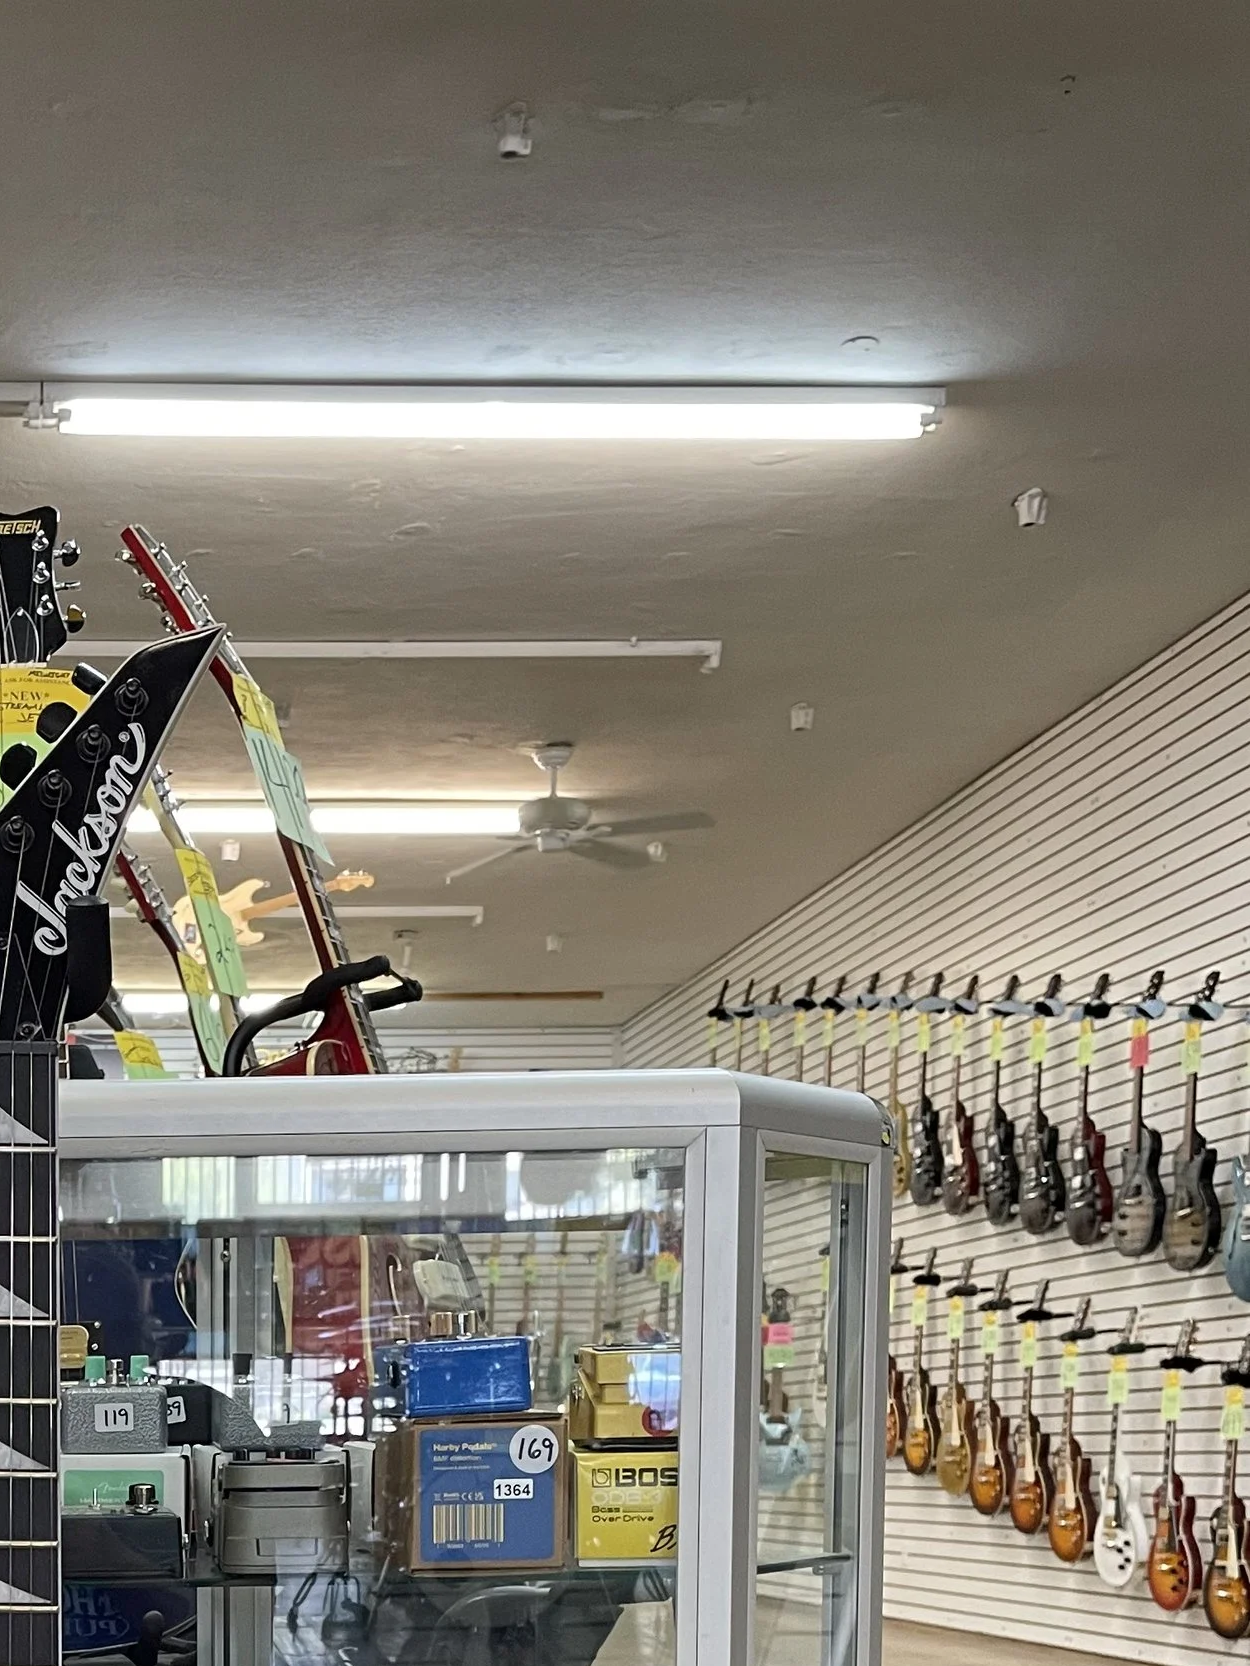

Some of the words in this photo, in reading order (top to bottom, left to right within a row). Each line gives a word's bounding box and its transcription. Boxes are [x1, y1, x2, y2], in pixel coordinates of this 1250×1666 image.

[17, 722, 146, 956] Jackson
[104, 1408, 129, 1427] 119
[518, 1437, 554, 1462] 169
[615, 1467, 678, 1487] BOS
[495, 1484, 531, 1497] 1364
[592, 1505, 621, 1514] Bass
